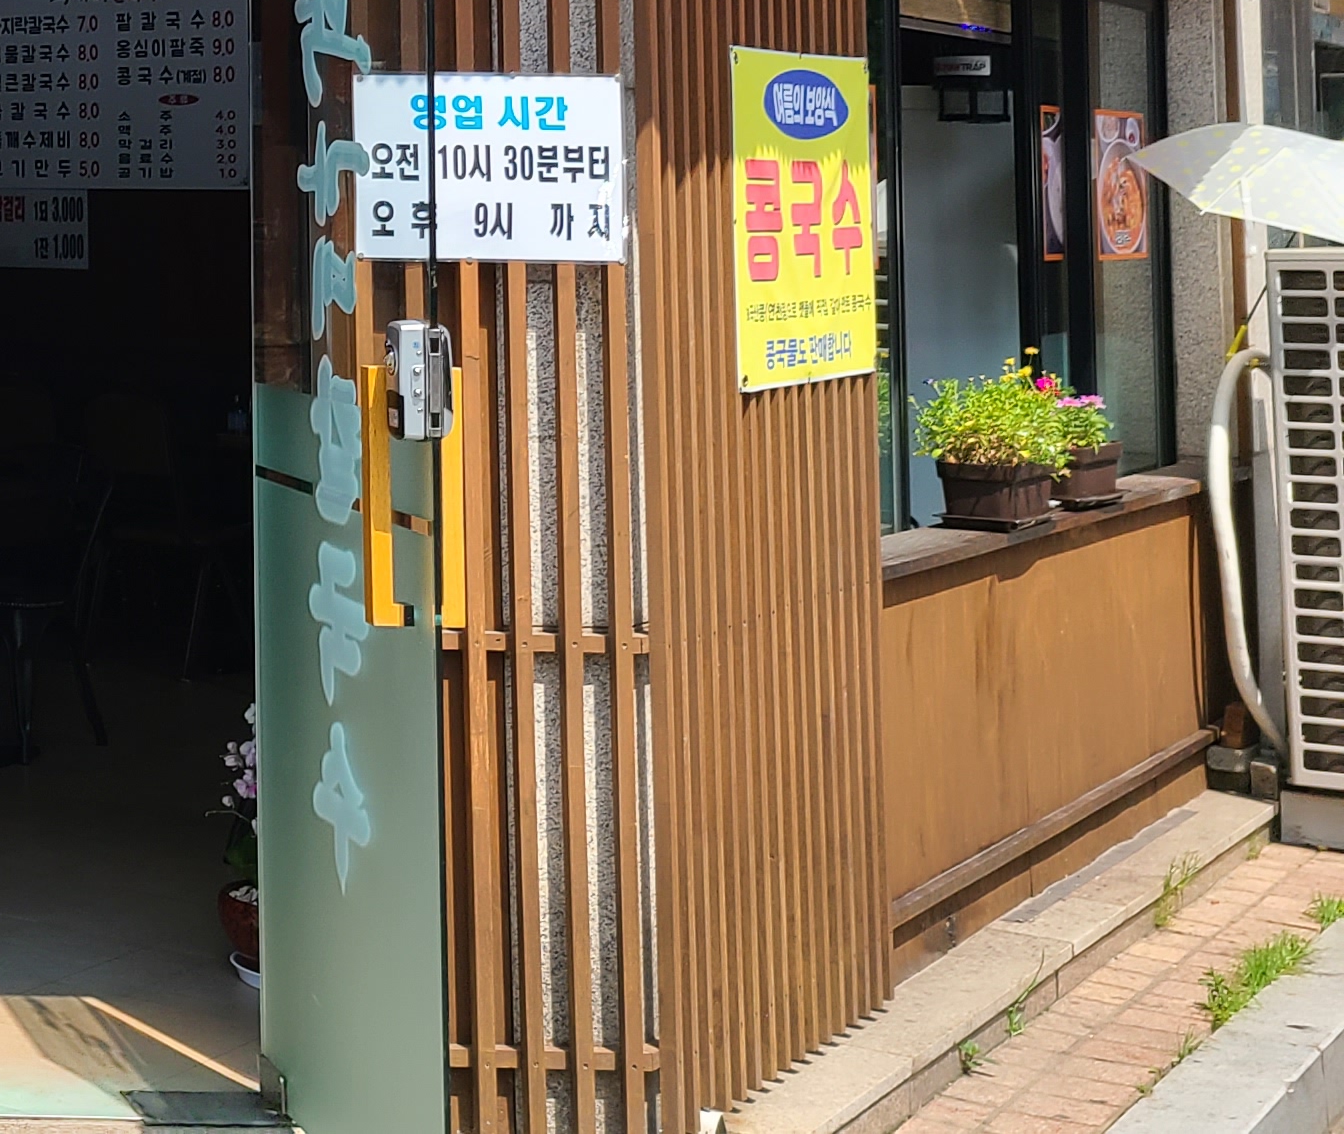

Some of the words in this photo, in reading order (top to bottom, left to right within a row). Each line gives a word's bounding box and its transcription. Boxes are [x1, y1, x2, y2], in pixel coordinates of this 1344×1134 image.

[409, 94, 483, 130] 영업
[497, 96, 568, 131] 시간
[772, 83, 805, 125] 여름의
[805, 85, 838, 127] 보양식
[370, 142, 420, 182] 오전
[438, 144, 493, 183] 10시
[503, 145, 611, 183] 30분부터
[474, 202, 514, 241] 9시
[744, 157, 864, 282] 콩국수
